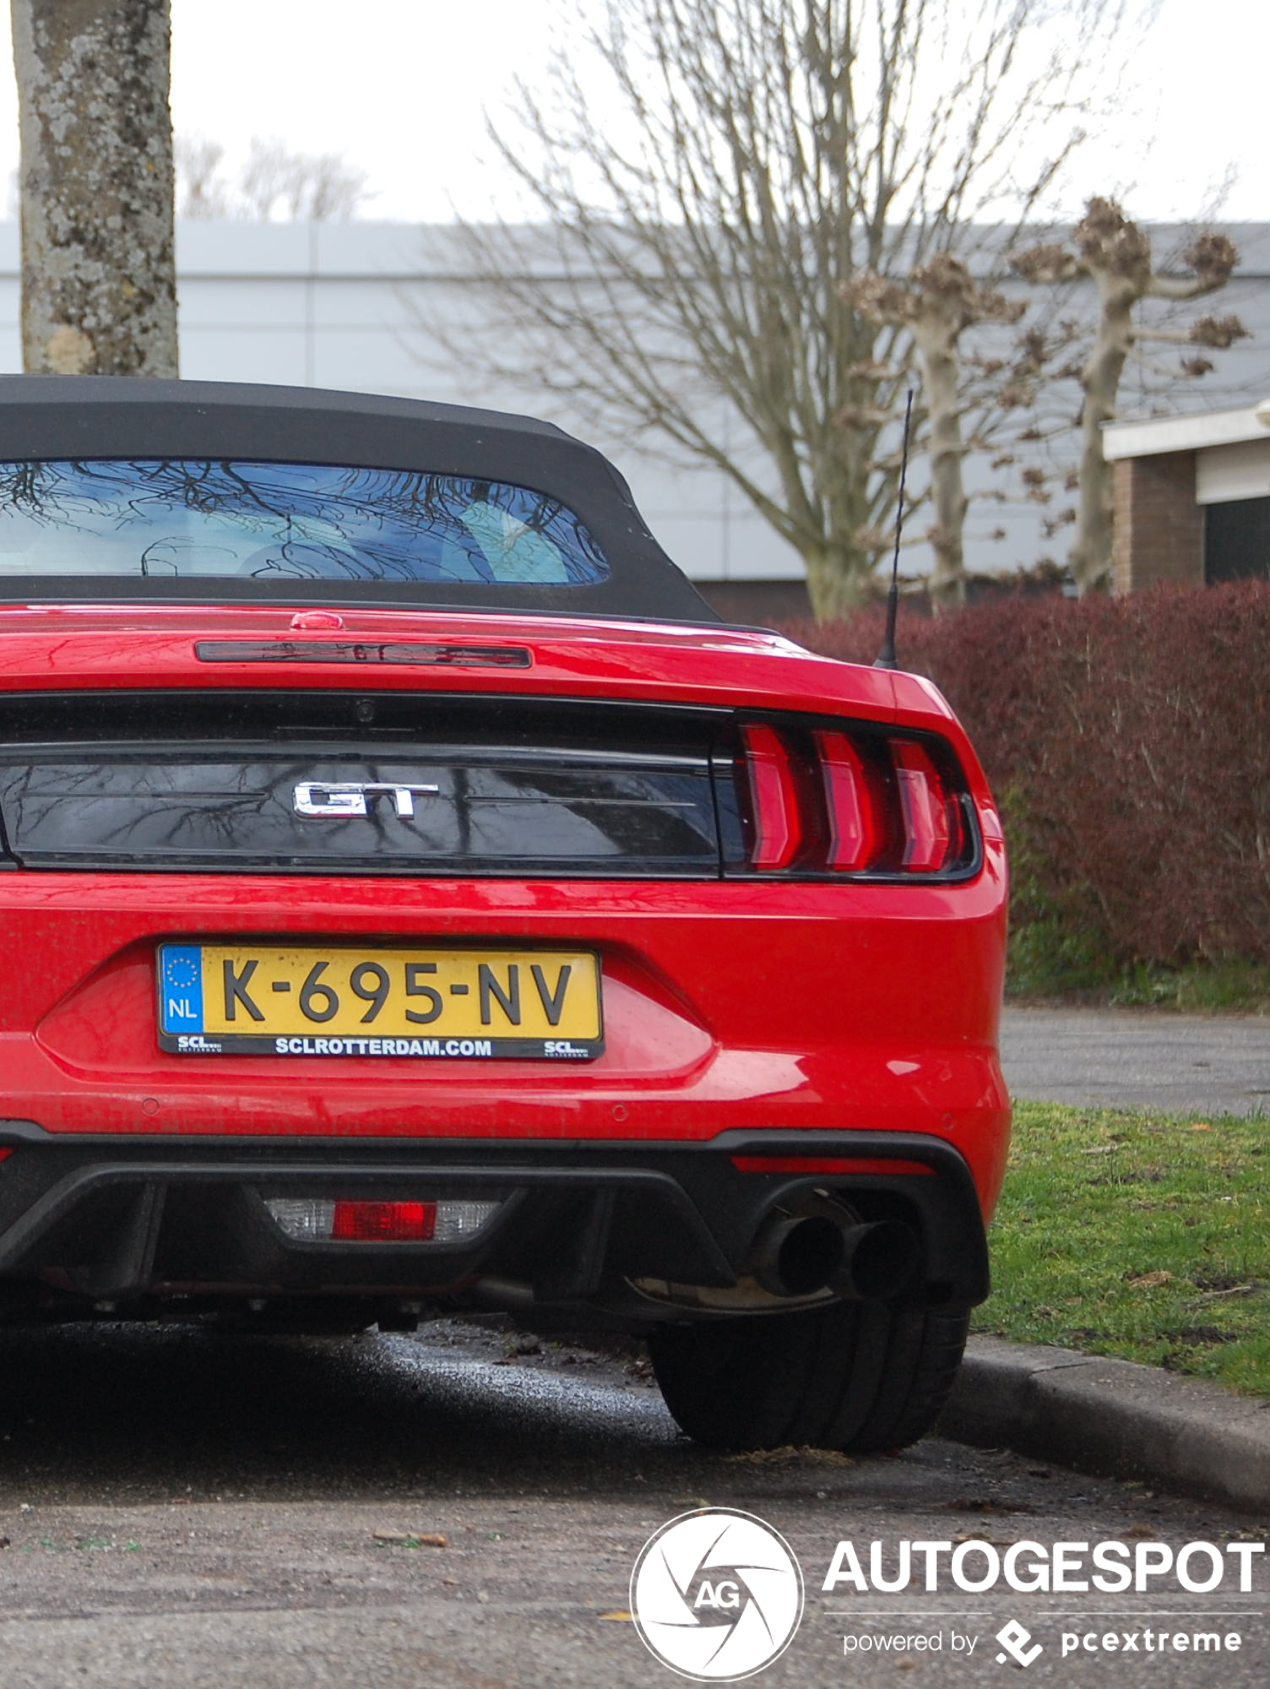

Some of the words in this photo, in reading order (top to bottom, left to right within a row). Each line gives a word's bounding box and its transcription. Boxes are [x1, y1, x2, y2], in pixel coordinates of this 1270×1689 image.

[293, 782, 439, 820] GT
[222, 959, 572, 1026] K-695-NV
[168, 998, 198, 1018] NL
[275, 1038, 492, 1055] SCLROTTERDAM.COM
